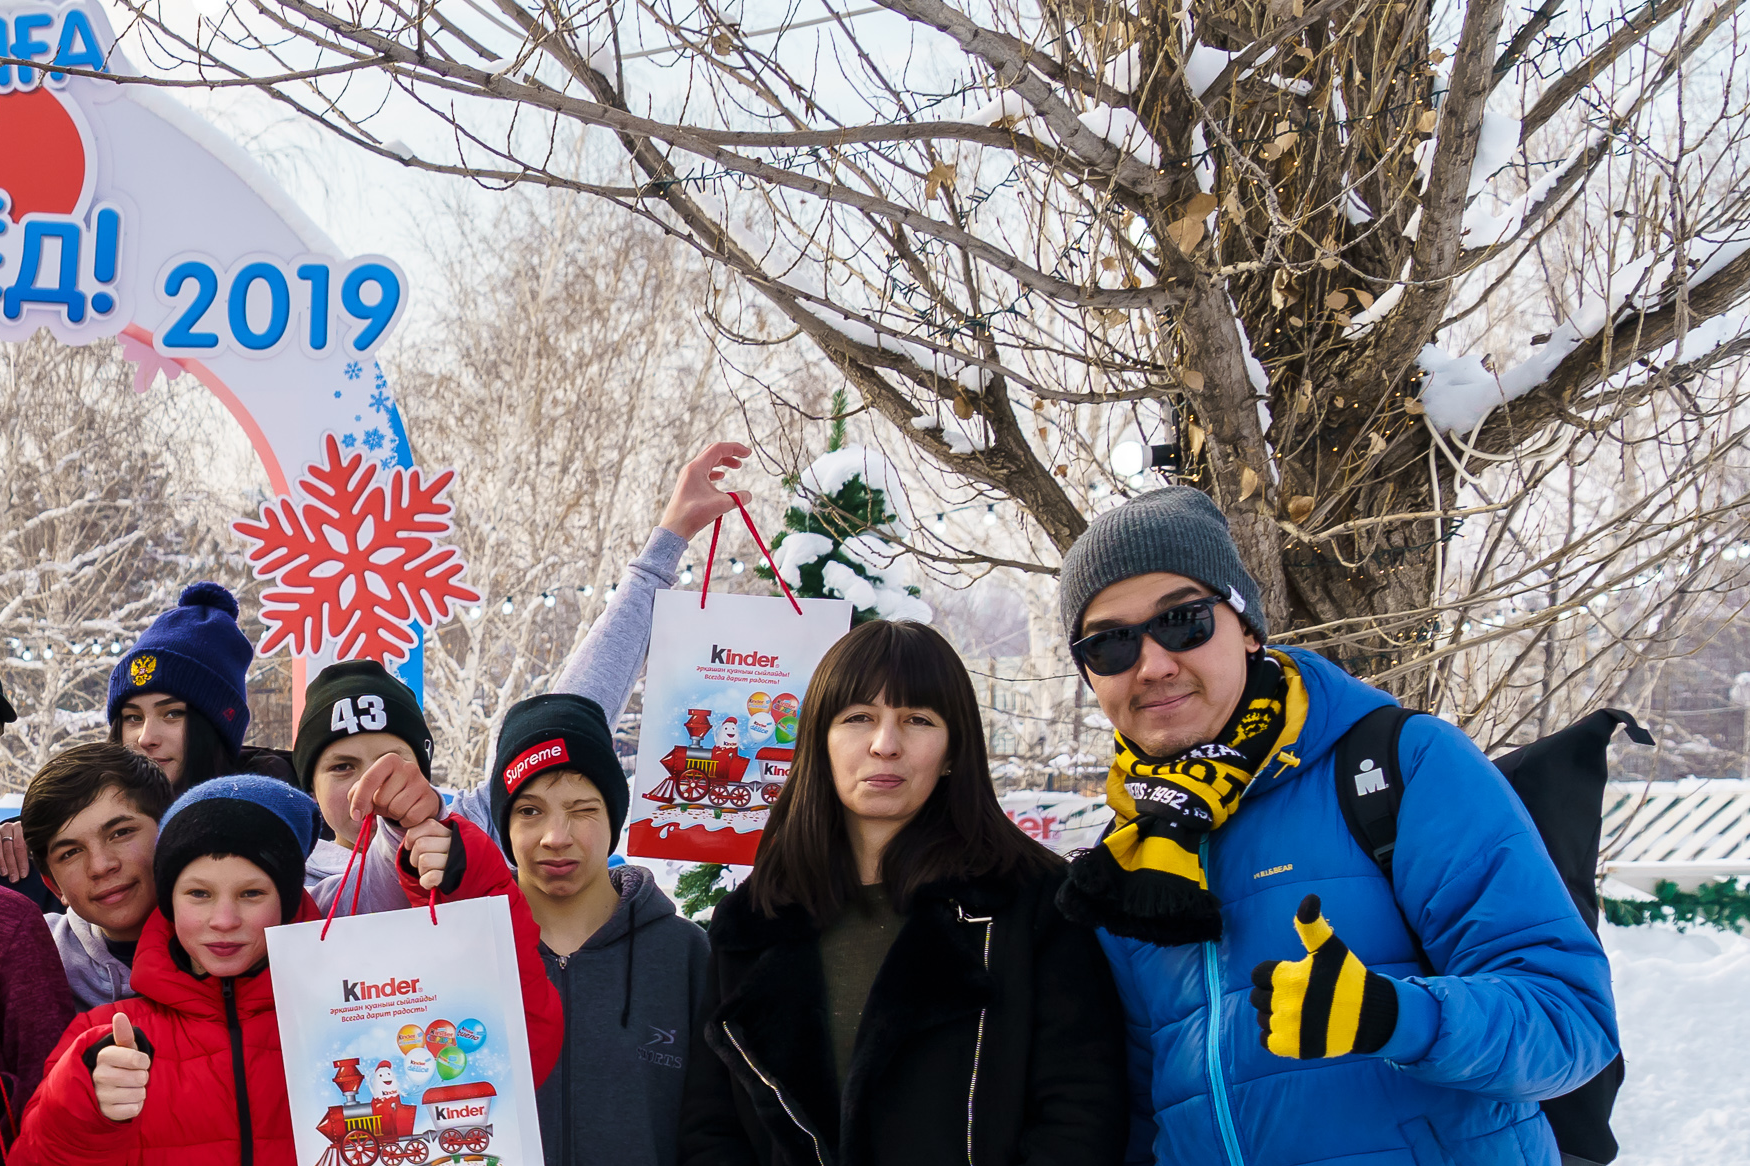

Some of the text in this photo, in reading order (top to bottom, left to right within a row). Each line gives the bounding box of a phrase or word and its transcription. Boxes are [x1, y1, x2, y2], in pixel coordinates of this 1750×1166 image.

[162, 261, 401, 352] 2019
[331, 695, 387, 735] 43
[506, 745, 562, 785] Supreme
